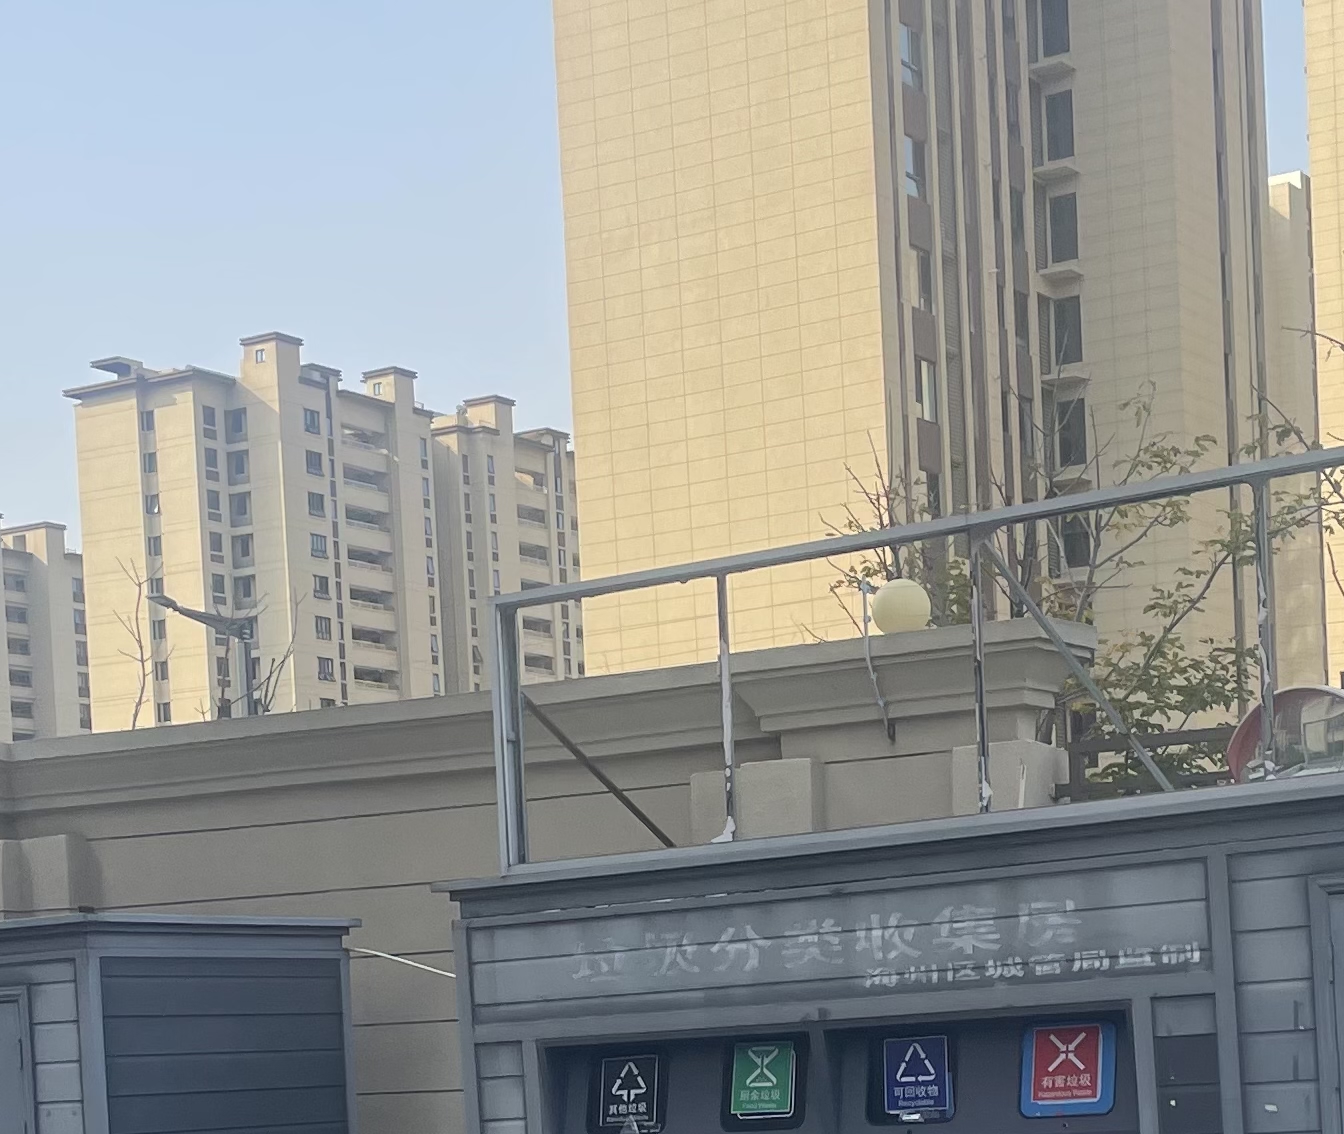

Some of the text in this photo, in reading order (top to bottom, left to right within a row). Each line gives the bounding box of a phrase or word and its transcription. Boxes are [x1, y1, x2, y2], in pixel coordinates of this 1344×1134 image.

[1041, 1073, 1092, 1089] 有害垃圾
[739, 1089, 781, 1101] 厨余垃圾
[894, 1085, 940, 1099] 可回收物
[609, 1101, 648, 1115] 其他垃圾
